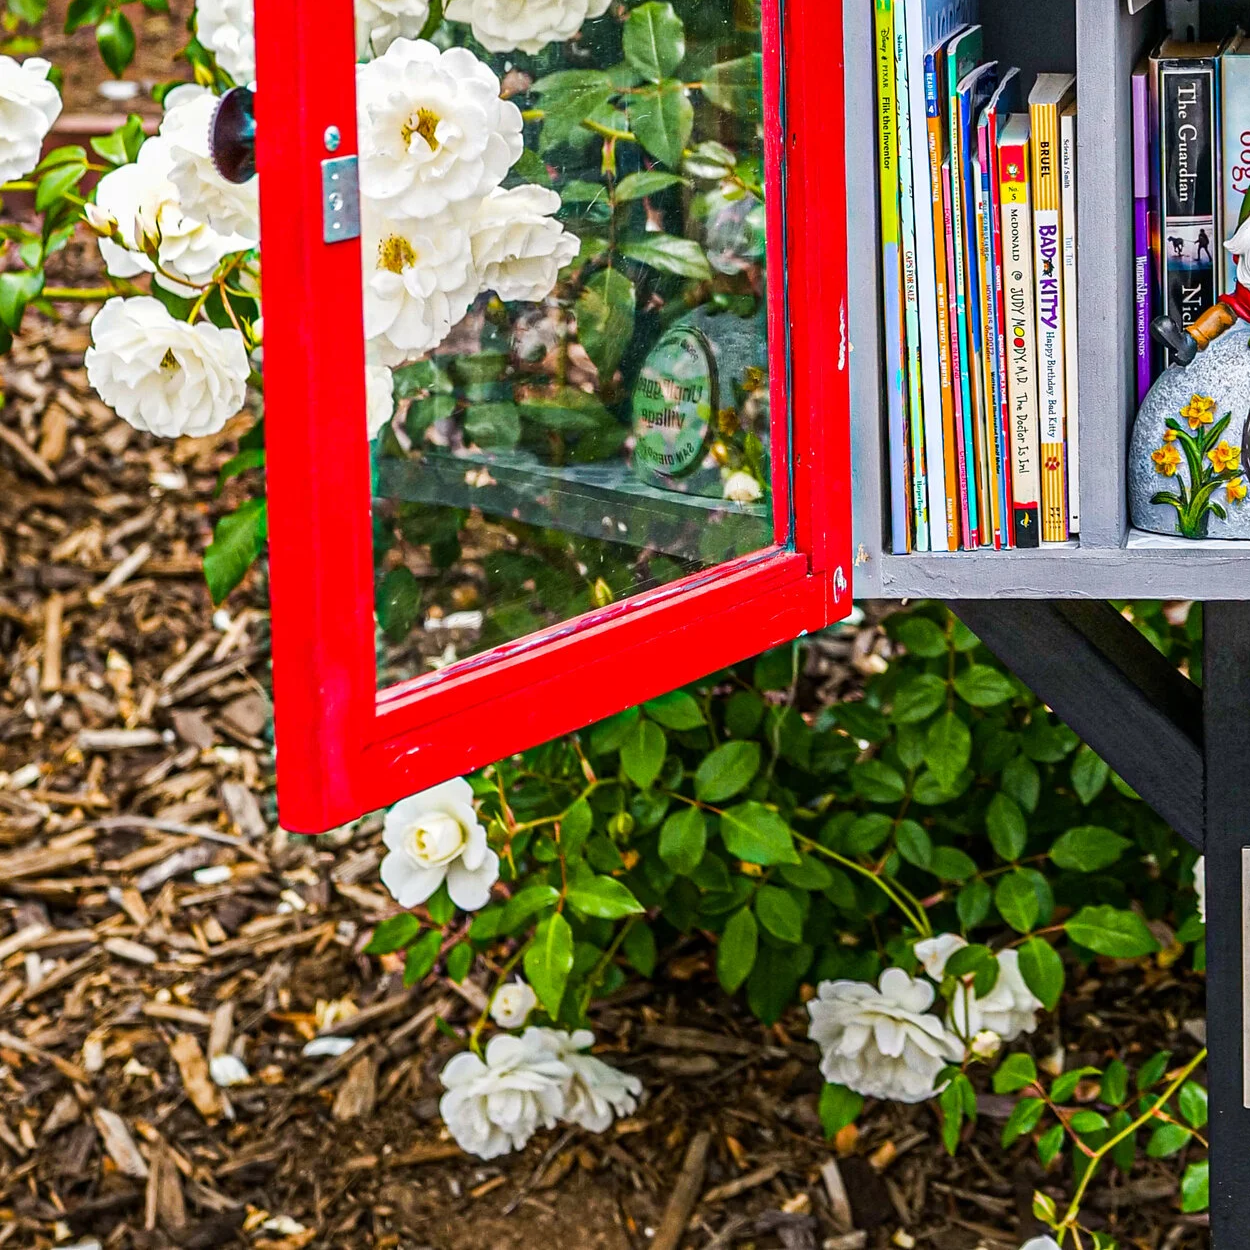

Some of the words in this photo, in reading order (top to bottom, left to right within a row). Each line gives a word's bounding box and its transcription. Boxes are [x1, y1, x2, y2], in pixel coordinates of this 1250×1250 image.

[880, 26, 890, 53] Disney
[880, 64, 889, 88] PIXAR
[926, 72, 934, 100] READING
[882, 97, 891, 114] Flik
[1177, 82, 1197, 119] The
[882, 115, 891, 131] the
[882, 131, 891, 170] Inventor
[1040, 141, 1050, 178] BRUEL
[1178, 124, 1198, 202] Guardian
[1010, 209, 1020, 261] McDONALD
[1038, 224, 1057, 257] BAD
[905, 250, 914, 270] CAPS
[1066, 252, 1074, 266] Tut
[906, 271, 914, 284] FOR
[907, 285, 915, 303] SALE
[1010, 287, 1024, 315] JUDY
[1040, 278, 1058, 330] KITTY
[1046, 331, 1056, 360] Happy
[1014, 365, 1028, 386] M.D.
[1016, 392, 1028, 411] The
[1048, 399, 1057, 415] Bad
[1016, 414, 1028, 441] Doctor
[1047, 417, 1058, 438] Kitty
[1017, 446, 1029, 459] Is
